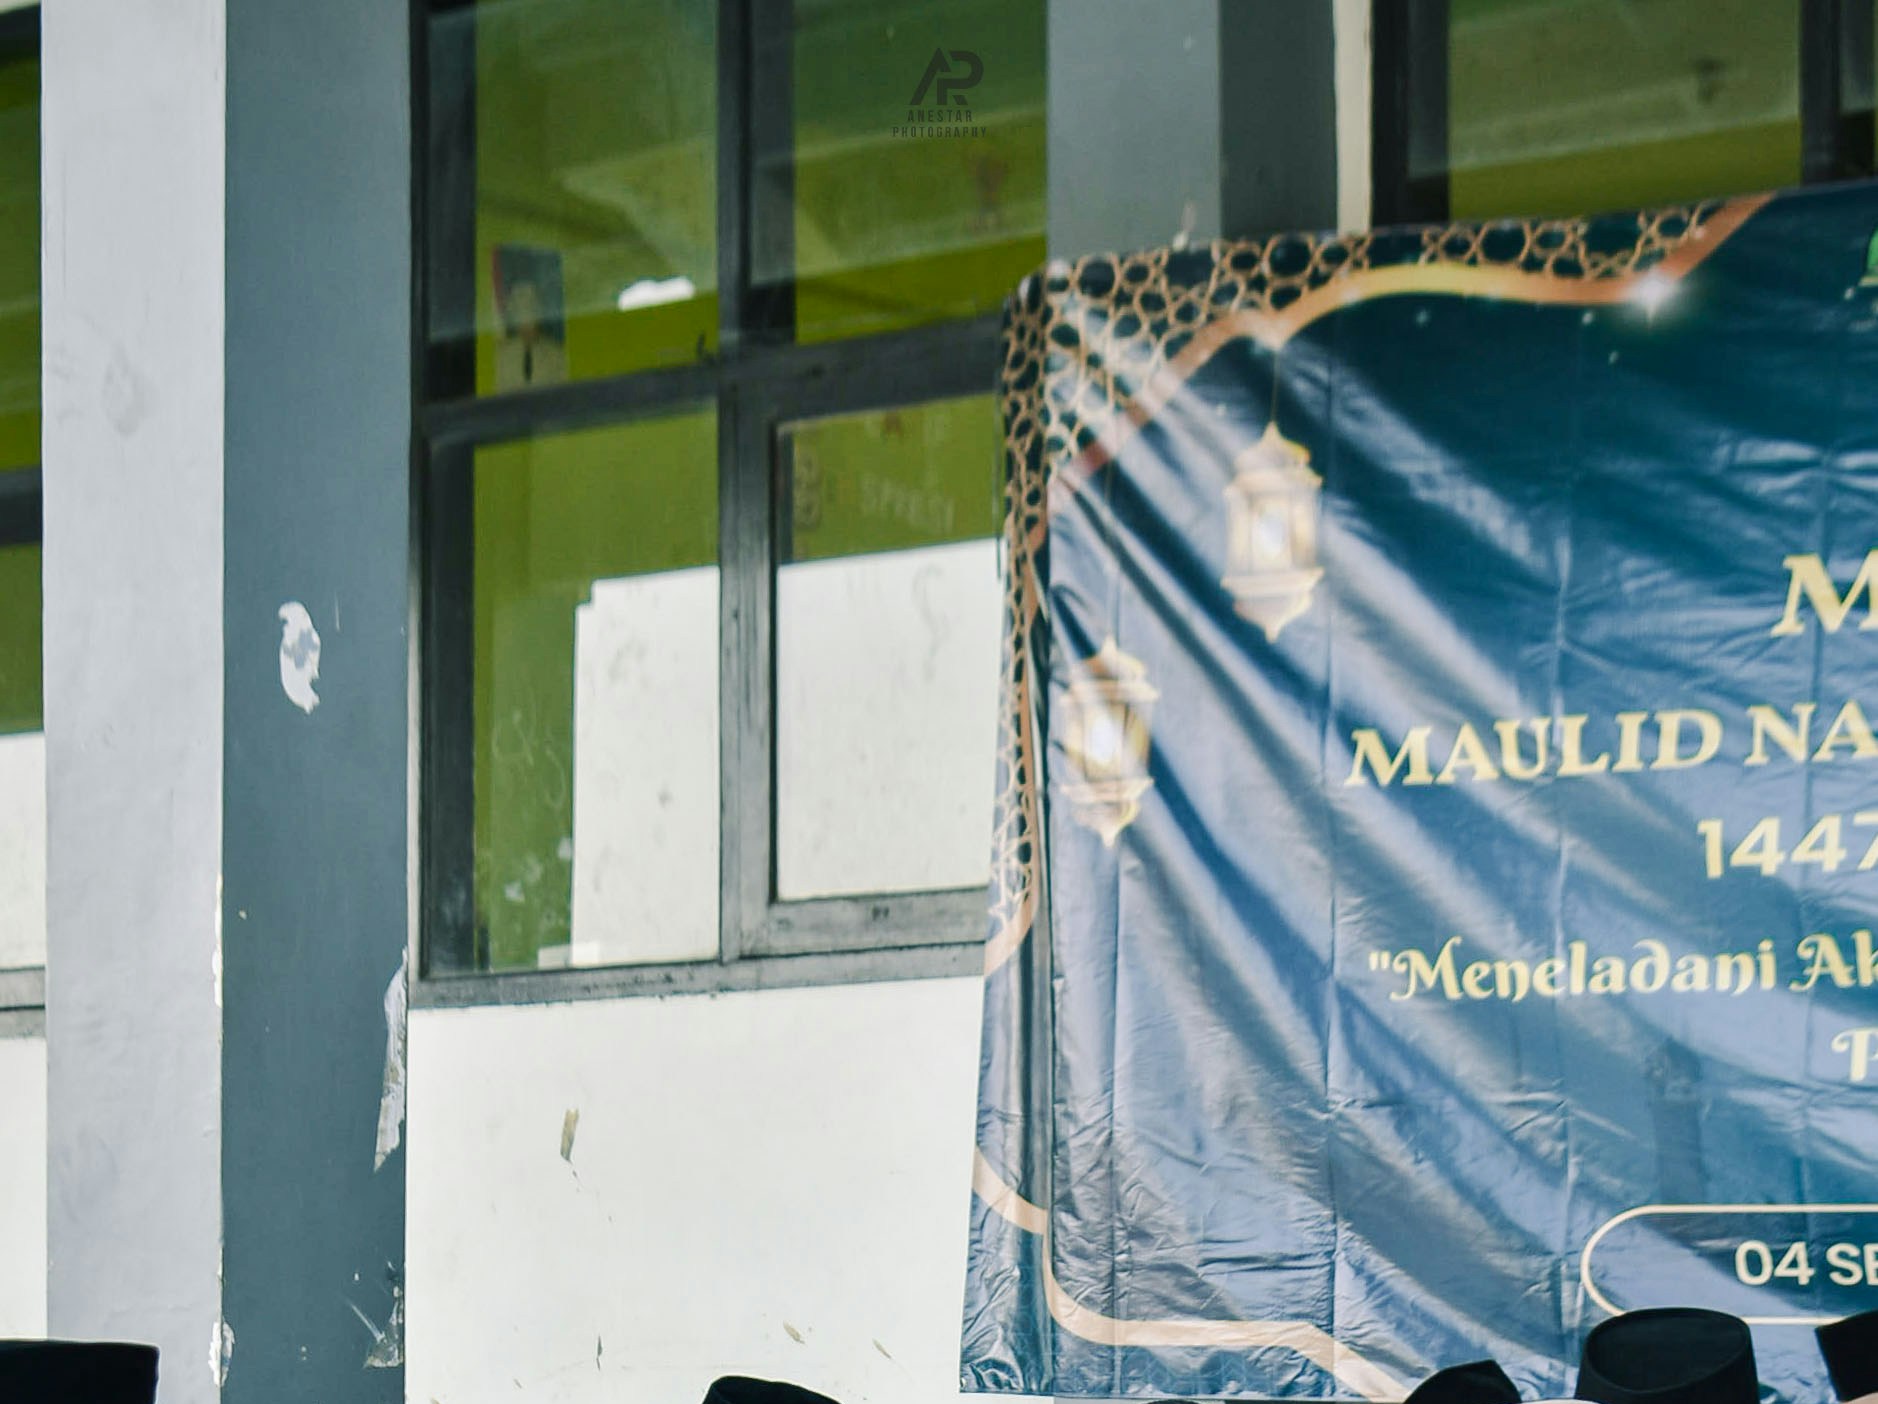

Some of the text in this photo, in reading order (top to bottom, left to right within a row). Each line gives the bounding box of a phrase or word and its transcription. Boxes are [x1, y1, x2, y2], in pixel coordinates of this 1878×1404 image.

[1343, 699, 1878, 787] MAULID NA
[1368, 935, 1777, 1002] "Meneladani
[1735, 1240, 1815, 1286] 04
